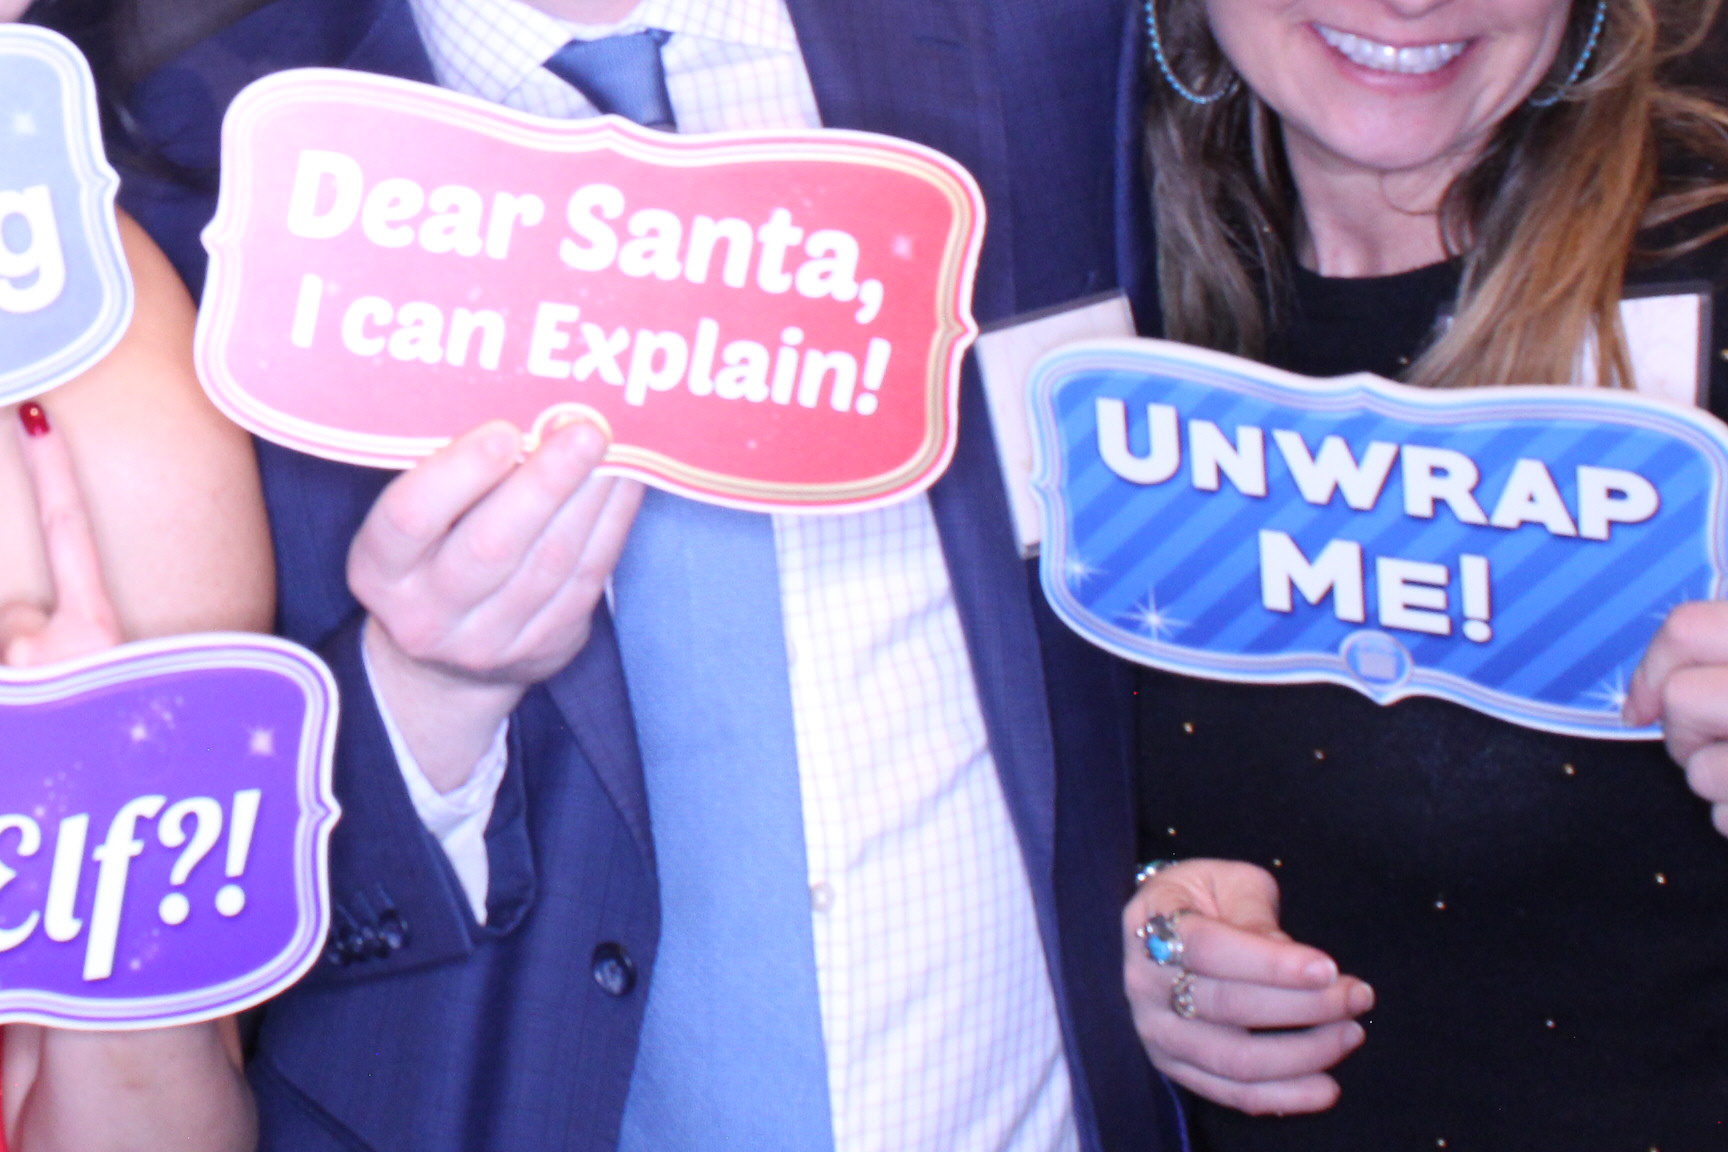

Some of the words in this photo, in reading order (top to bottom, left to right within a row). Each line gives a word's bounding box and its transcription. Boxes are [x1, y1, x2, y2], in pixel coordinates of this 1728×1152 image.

[287, 149, 545, 259] Dear
[558, 183, 883, 324] Santa,
[290, 274, 323, 349] I
[341, 292, 505, 370] can
[526, 301, 892, 416] Explain!
[1095, 397, 1660, 540] UNWRAP
[1259, 530, 1493, 643] ME!
